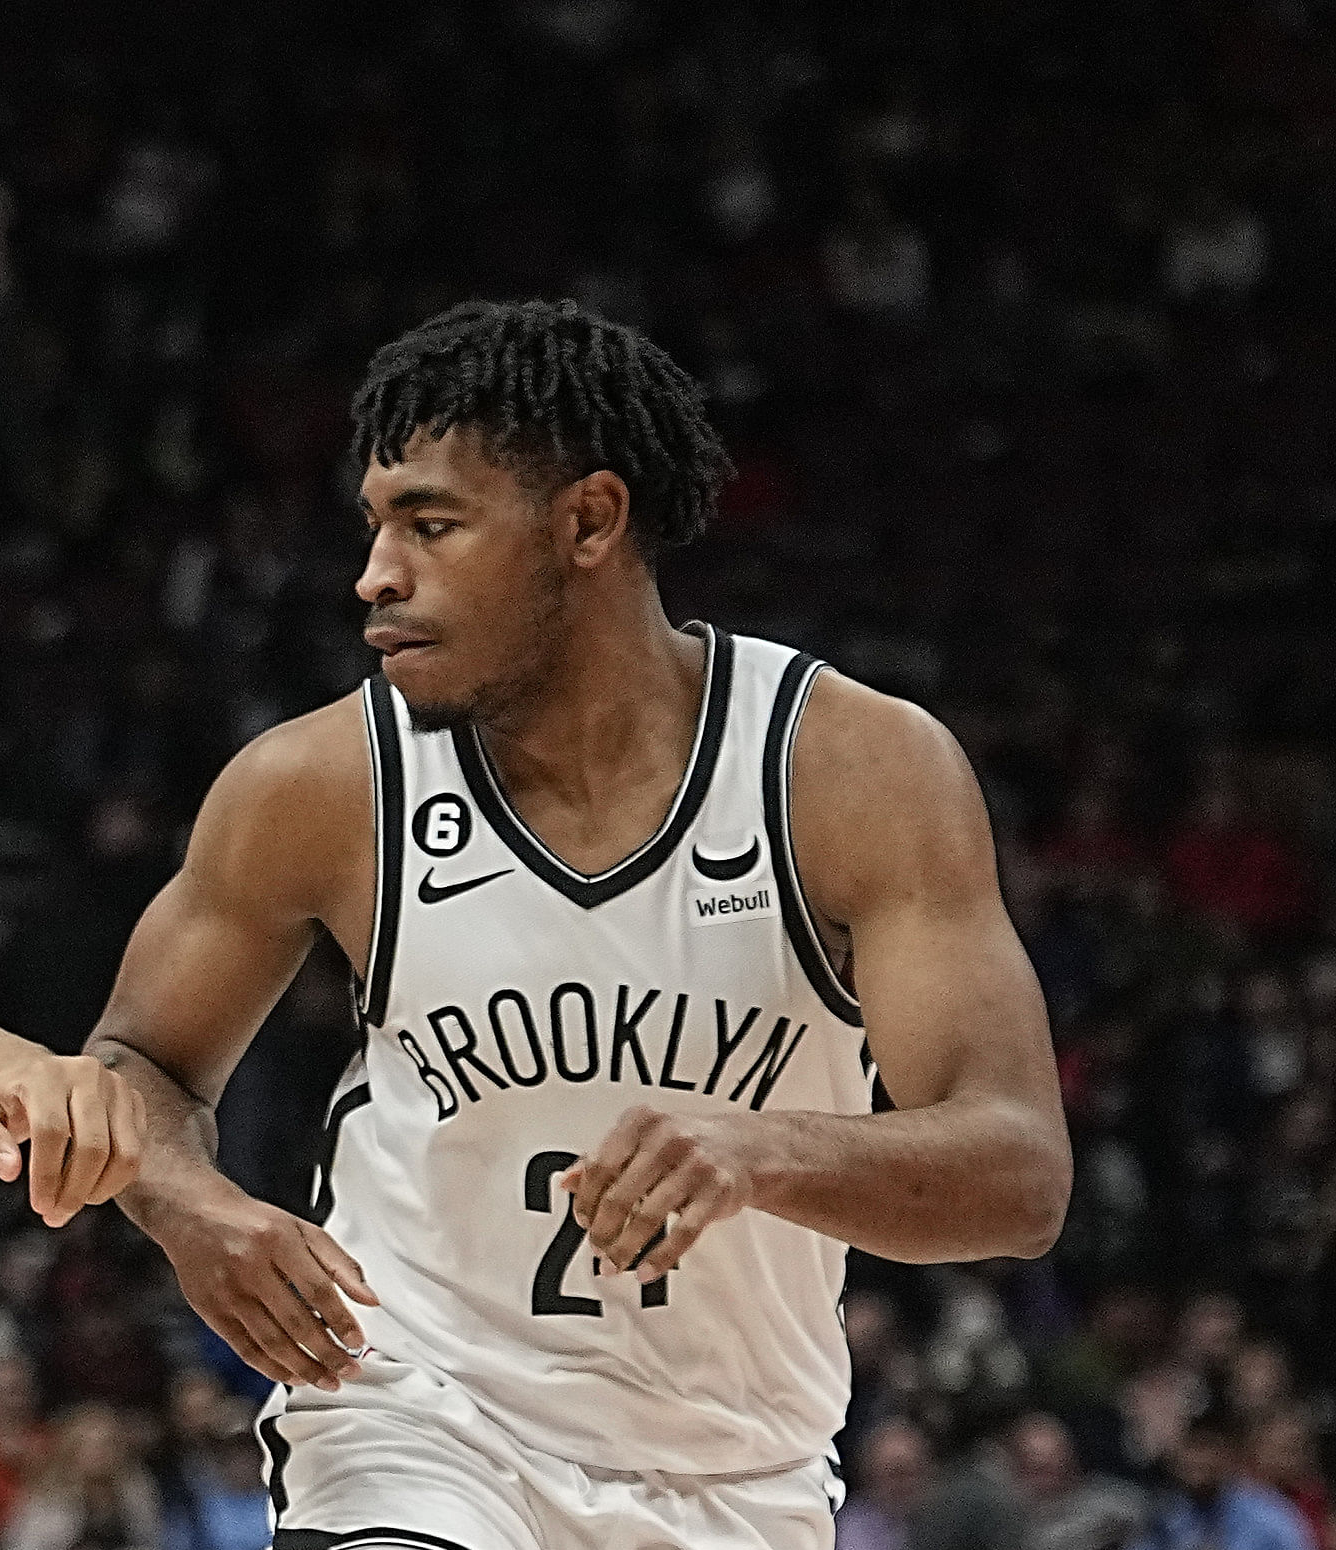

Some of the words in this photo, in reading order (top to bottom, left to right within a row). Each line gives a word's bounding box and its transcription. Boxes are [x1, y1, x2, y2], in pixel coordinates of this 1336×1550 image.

[426, 802, 461, 851] 6
[695, 889, 771, 918] Webull
[397, 981, 809, 1123] BROOKLYN
